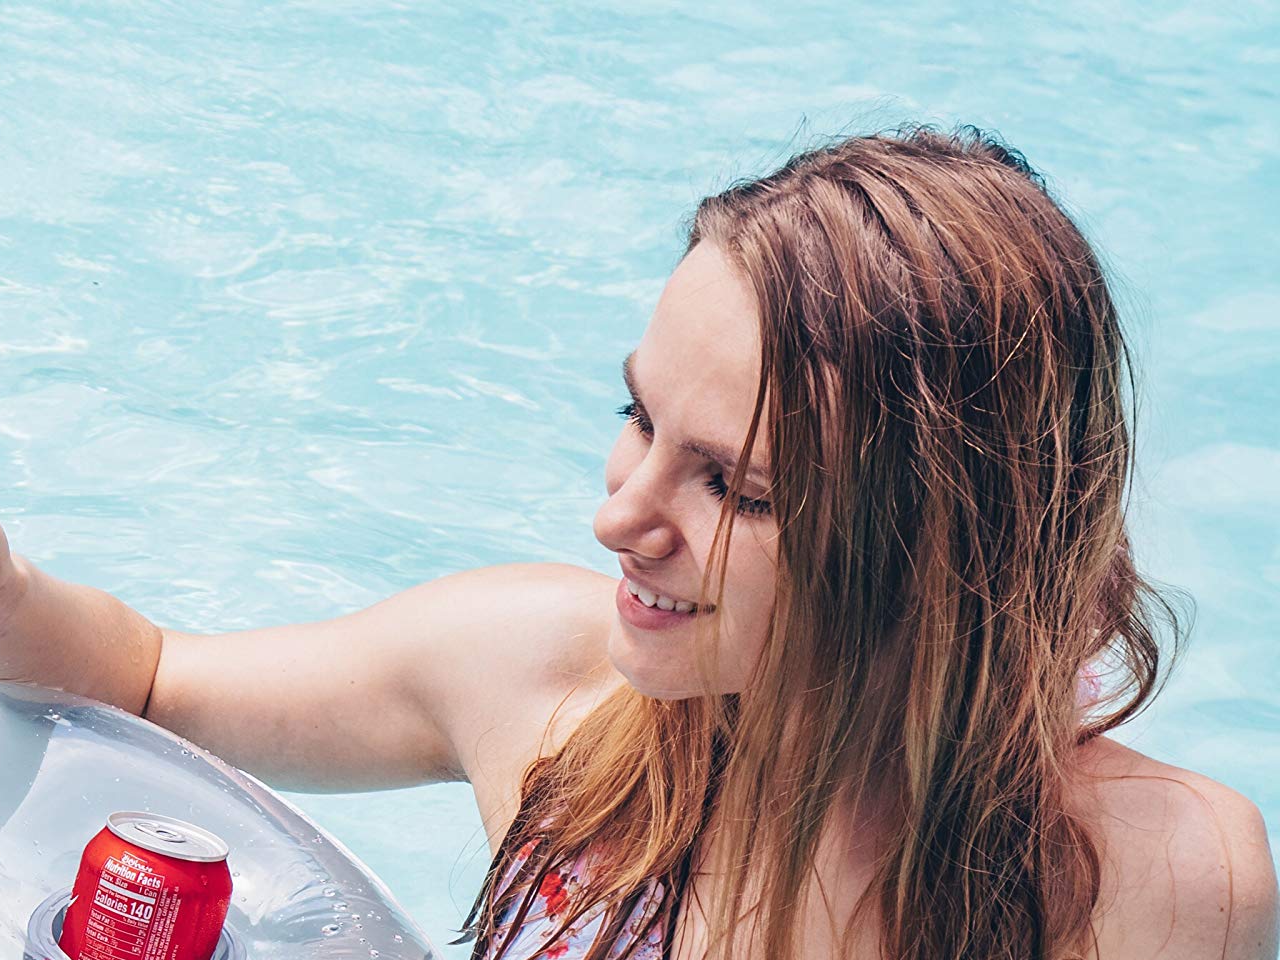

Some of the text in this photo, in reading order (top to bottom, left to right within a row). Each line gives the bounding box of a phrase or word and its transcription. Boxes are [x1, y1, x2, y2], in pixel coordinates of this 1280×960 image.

[105, 859, 136, 881] Nutrition
[137, 872, 161, 888] Facts
[115, 878, 128, 888] Size
[144, 889, 157, 897] Can
[95, 890, 153, 920] Calories 140
